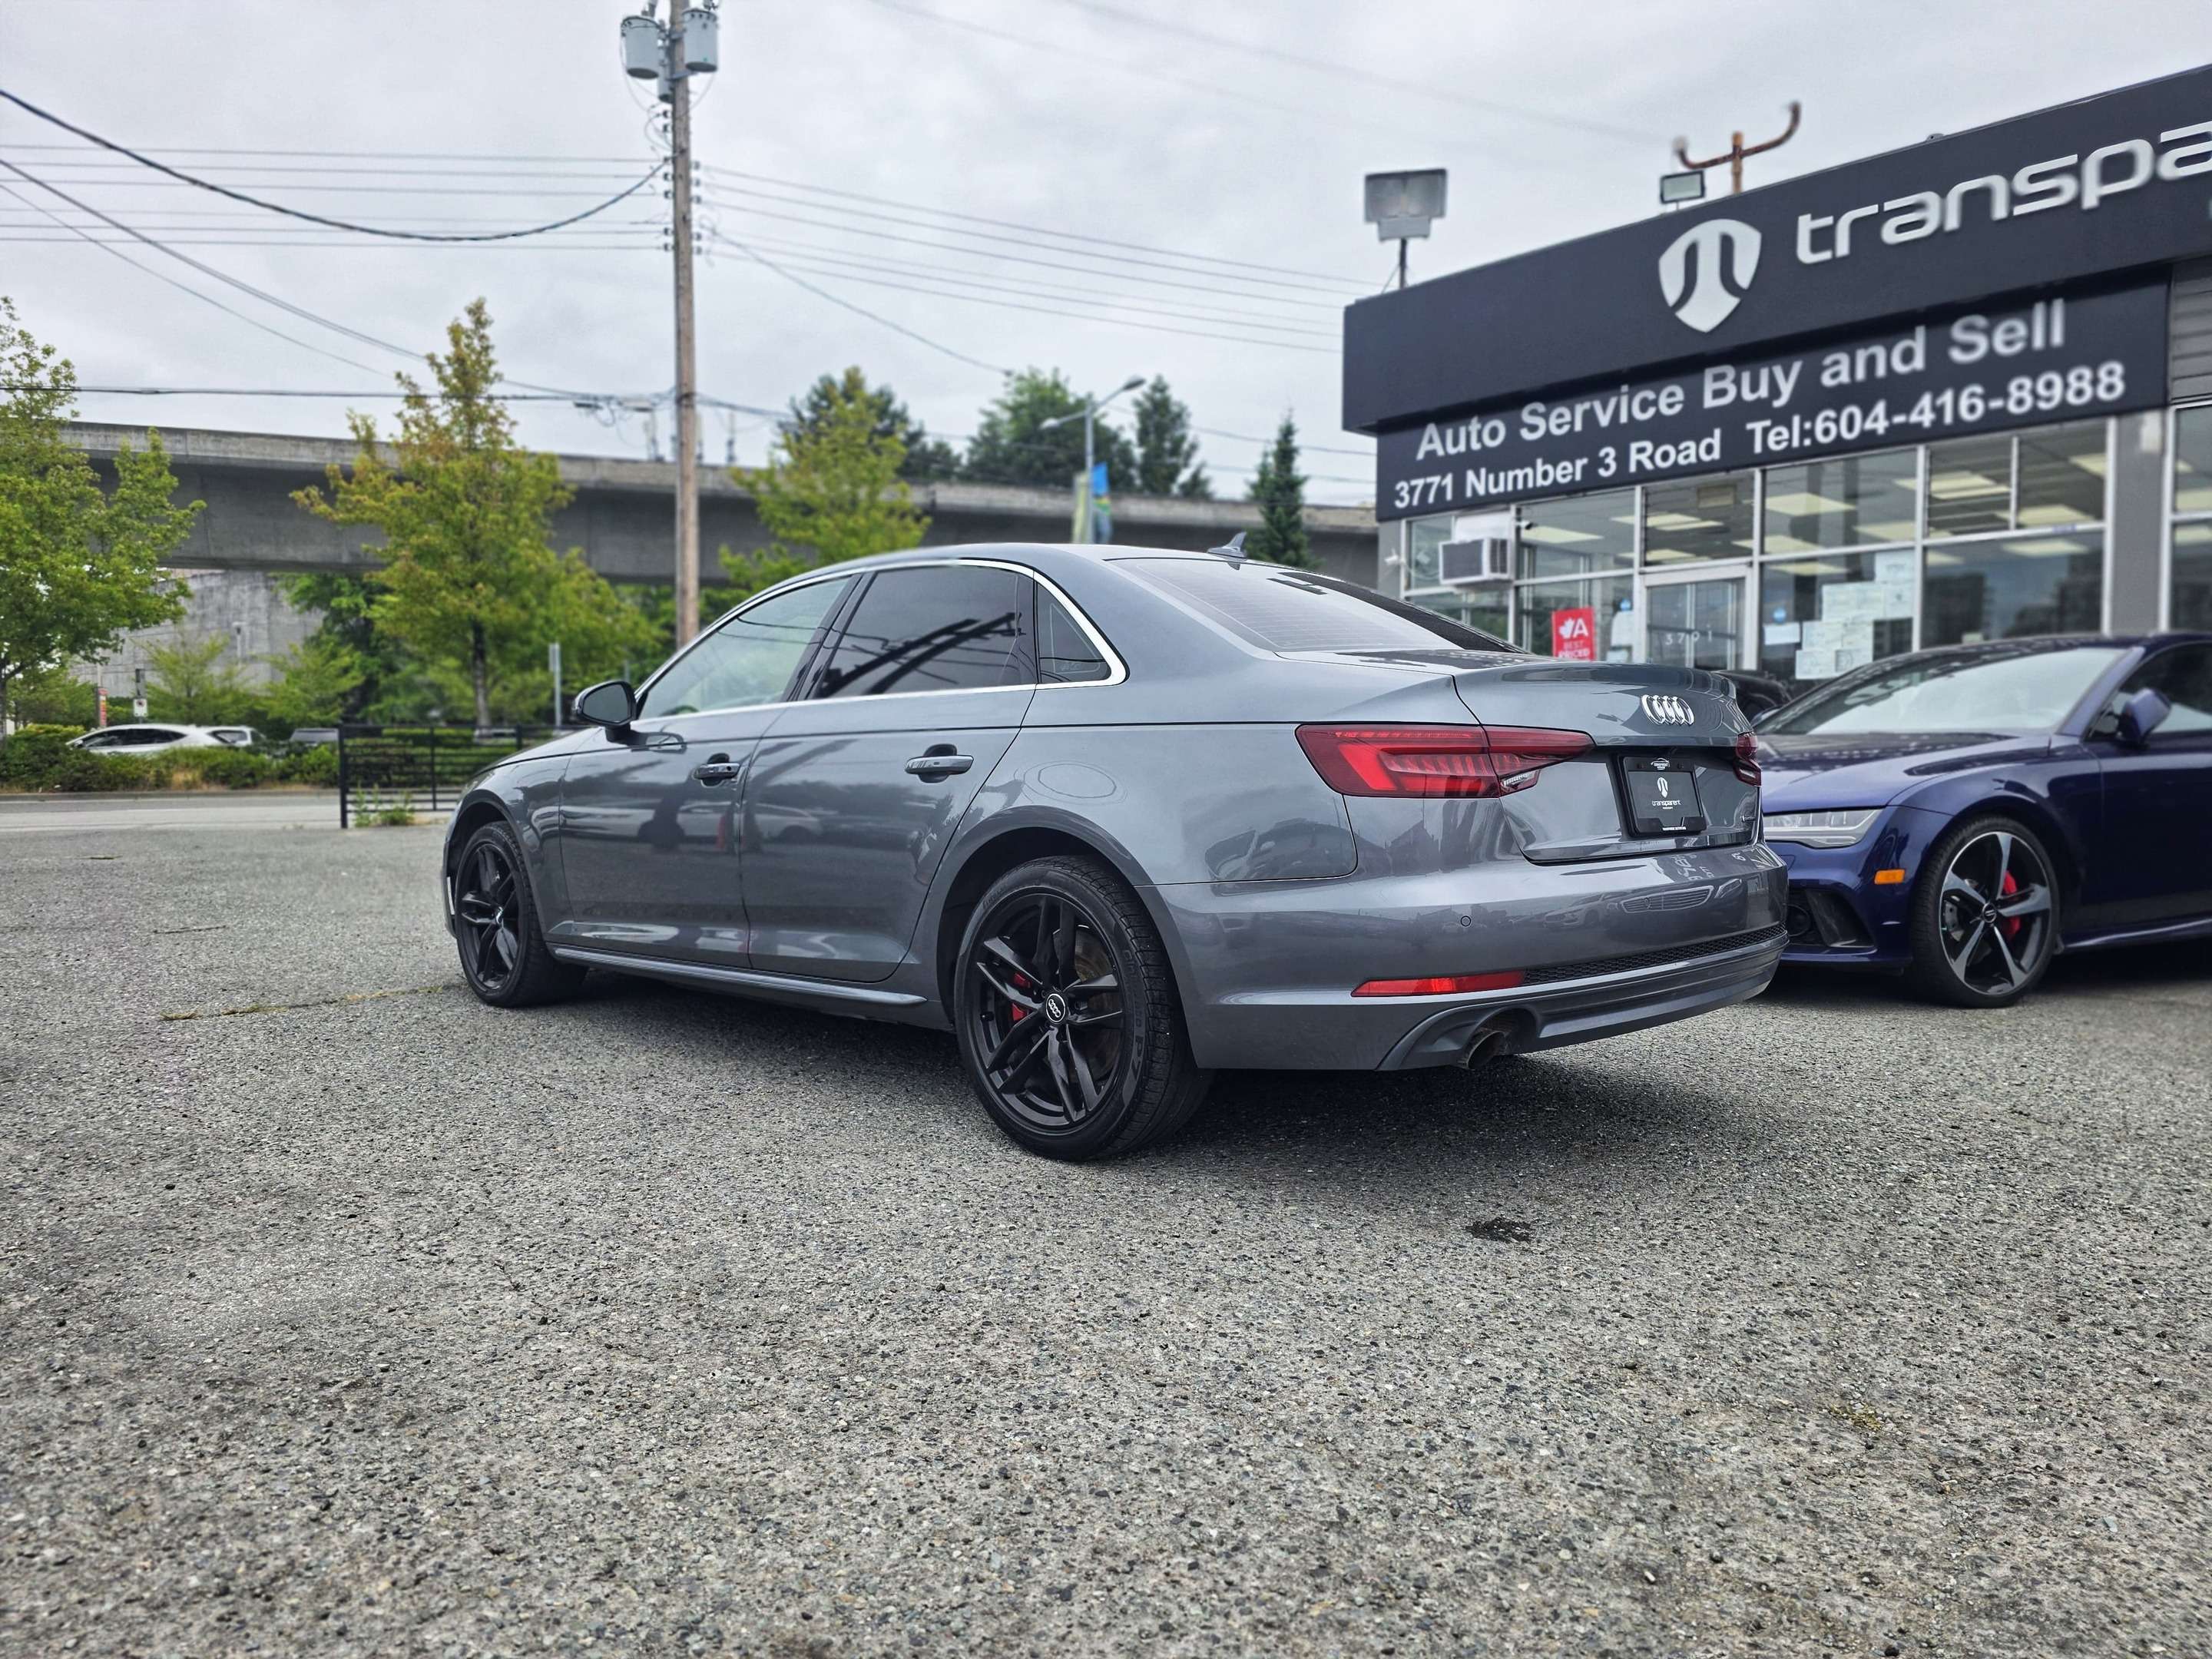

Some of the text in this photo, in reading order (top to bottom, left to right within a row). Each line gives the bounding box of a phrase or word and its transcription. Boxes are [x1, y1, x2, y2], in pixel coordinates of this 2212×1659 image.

[1796, 121, 2212, 265] transpa
[1394, 360, 2125, 508] 3771 Number 3 Road Tel:604-416-8988
[1416, 298, 2065, 460] Auto Service Buy and Sell
